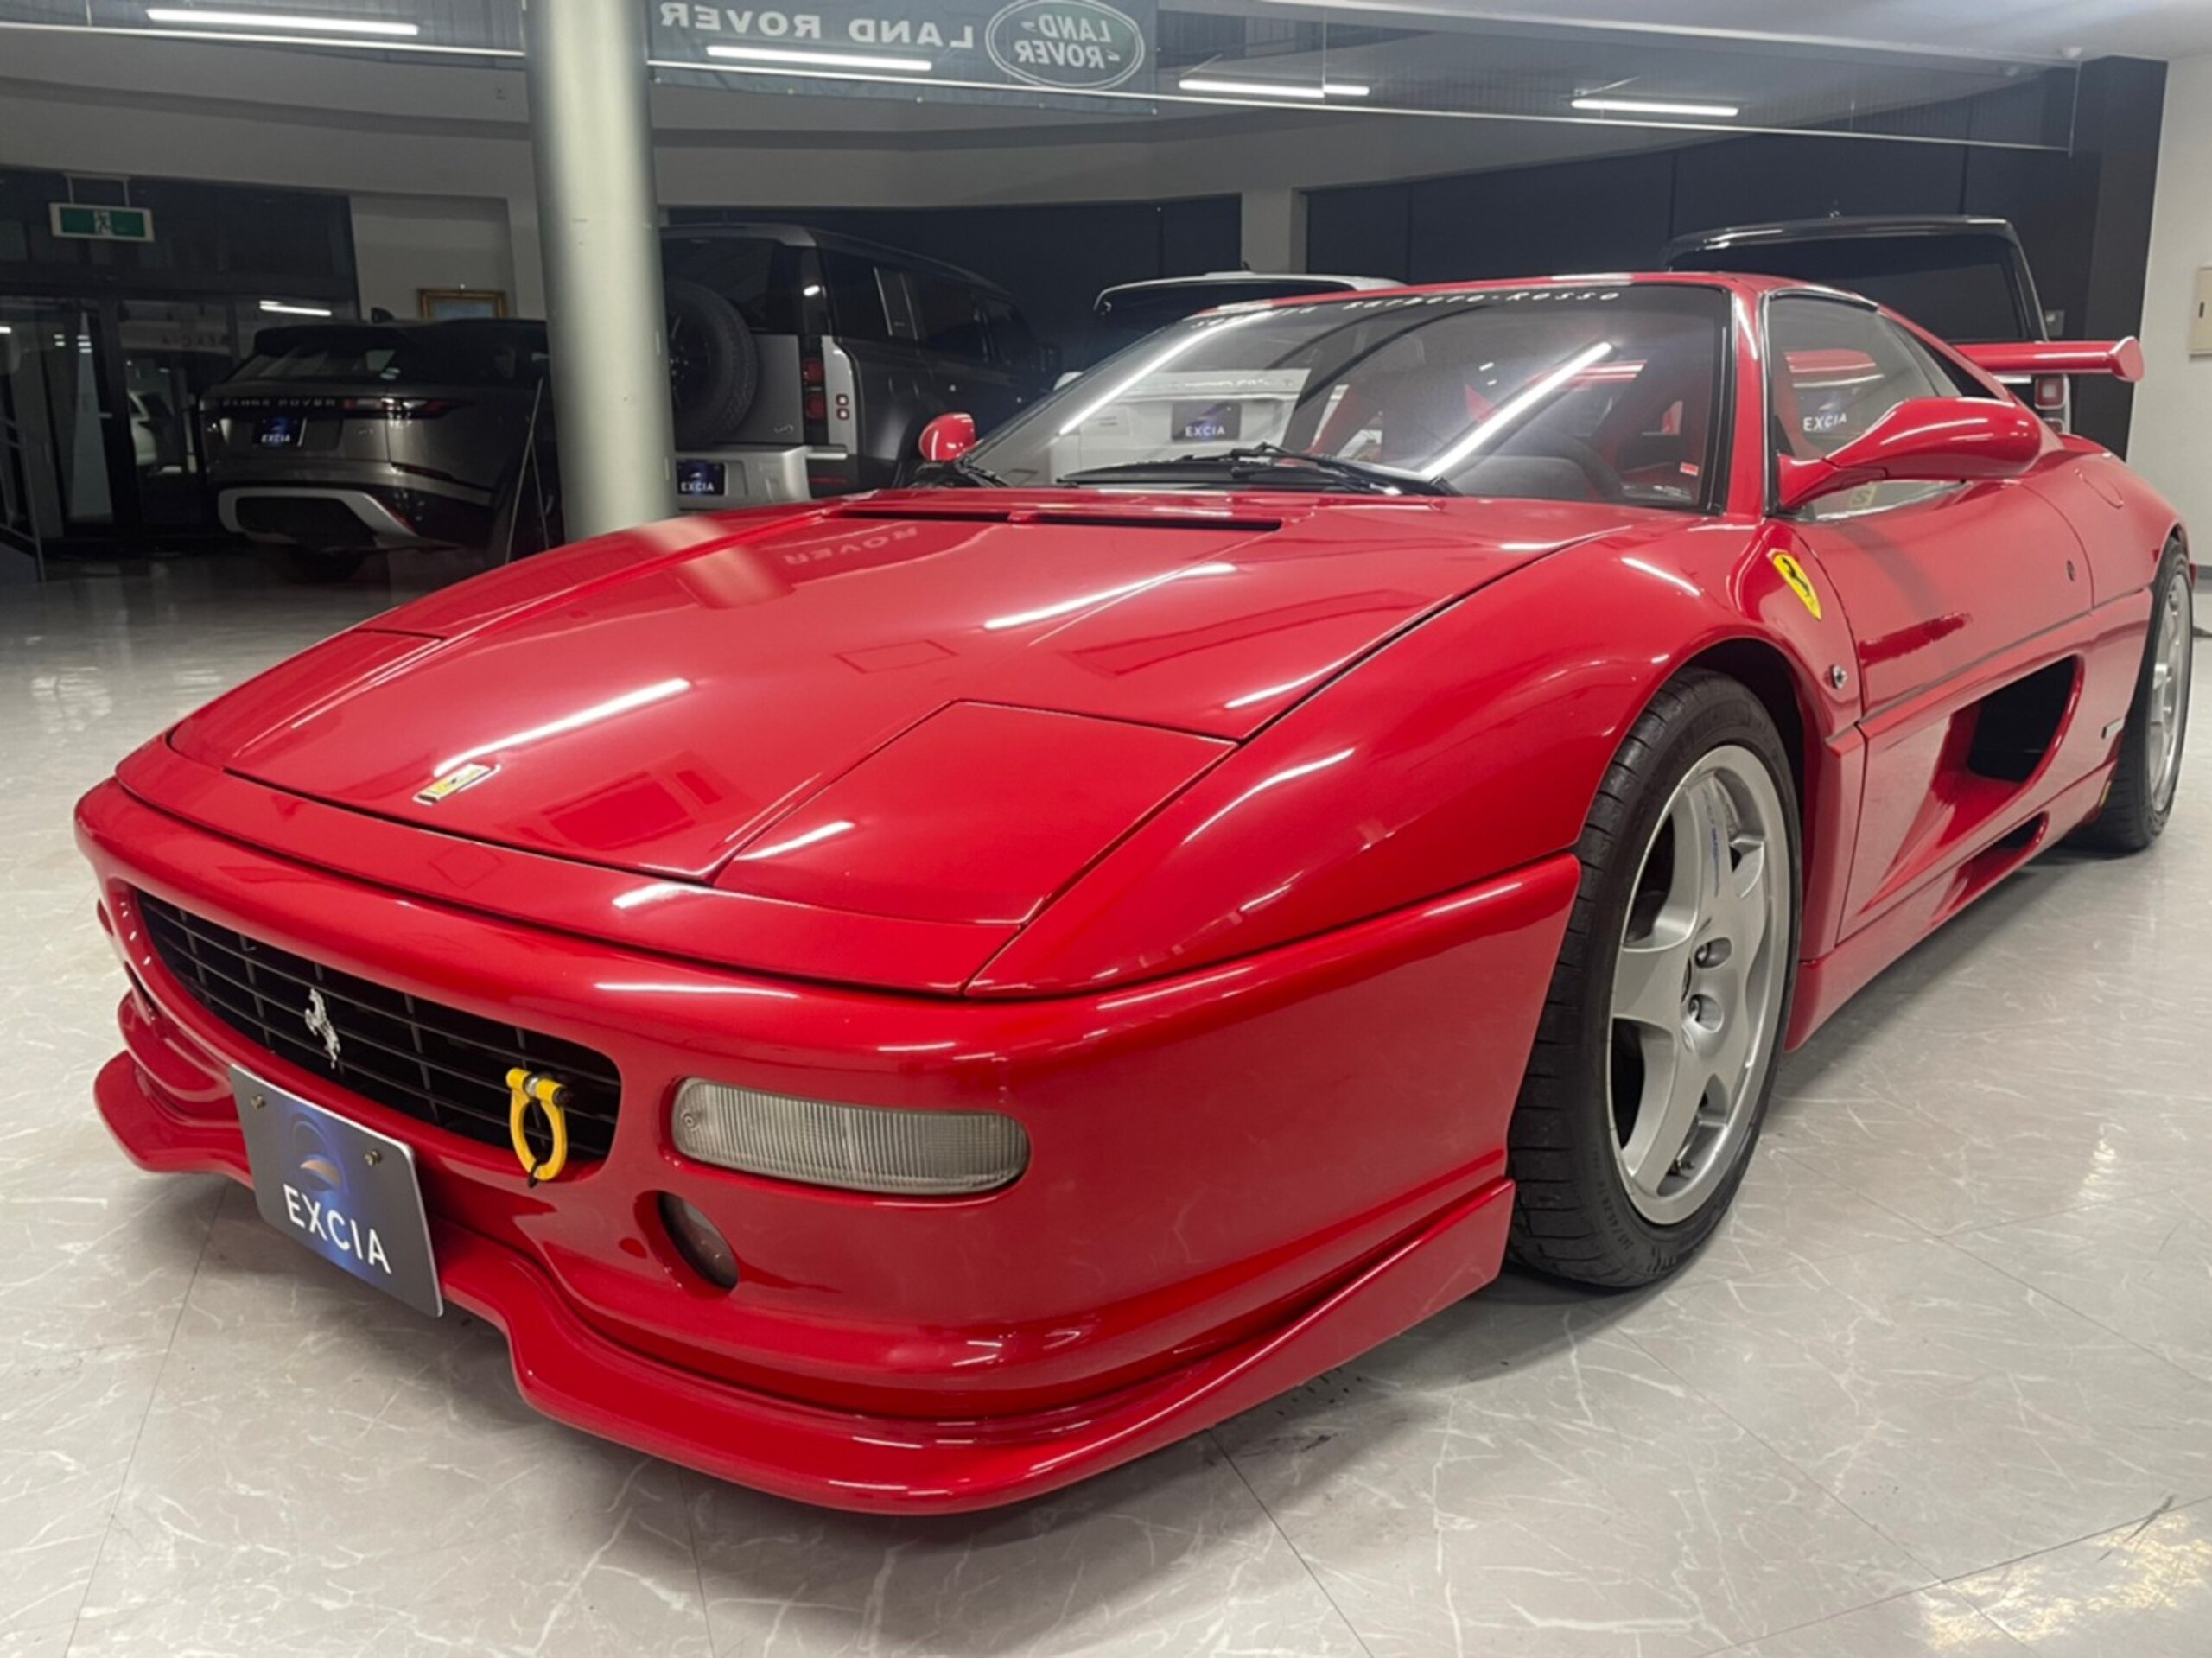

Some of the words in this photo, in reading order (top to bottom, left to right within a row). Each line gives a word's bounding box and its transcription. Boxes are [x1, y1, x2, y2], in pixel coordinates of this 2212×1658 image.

[1802, 413, 1847, 432] EXCIA
[1185, 426, 1225, 437] EXCIA
[680, 481, 715, 492] EXCIA
[282, 1183, 392, 1274] EXCIA
